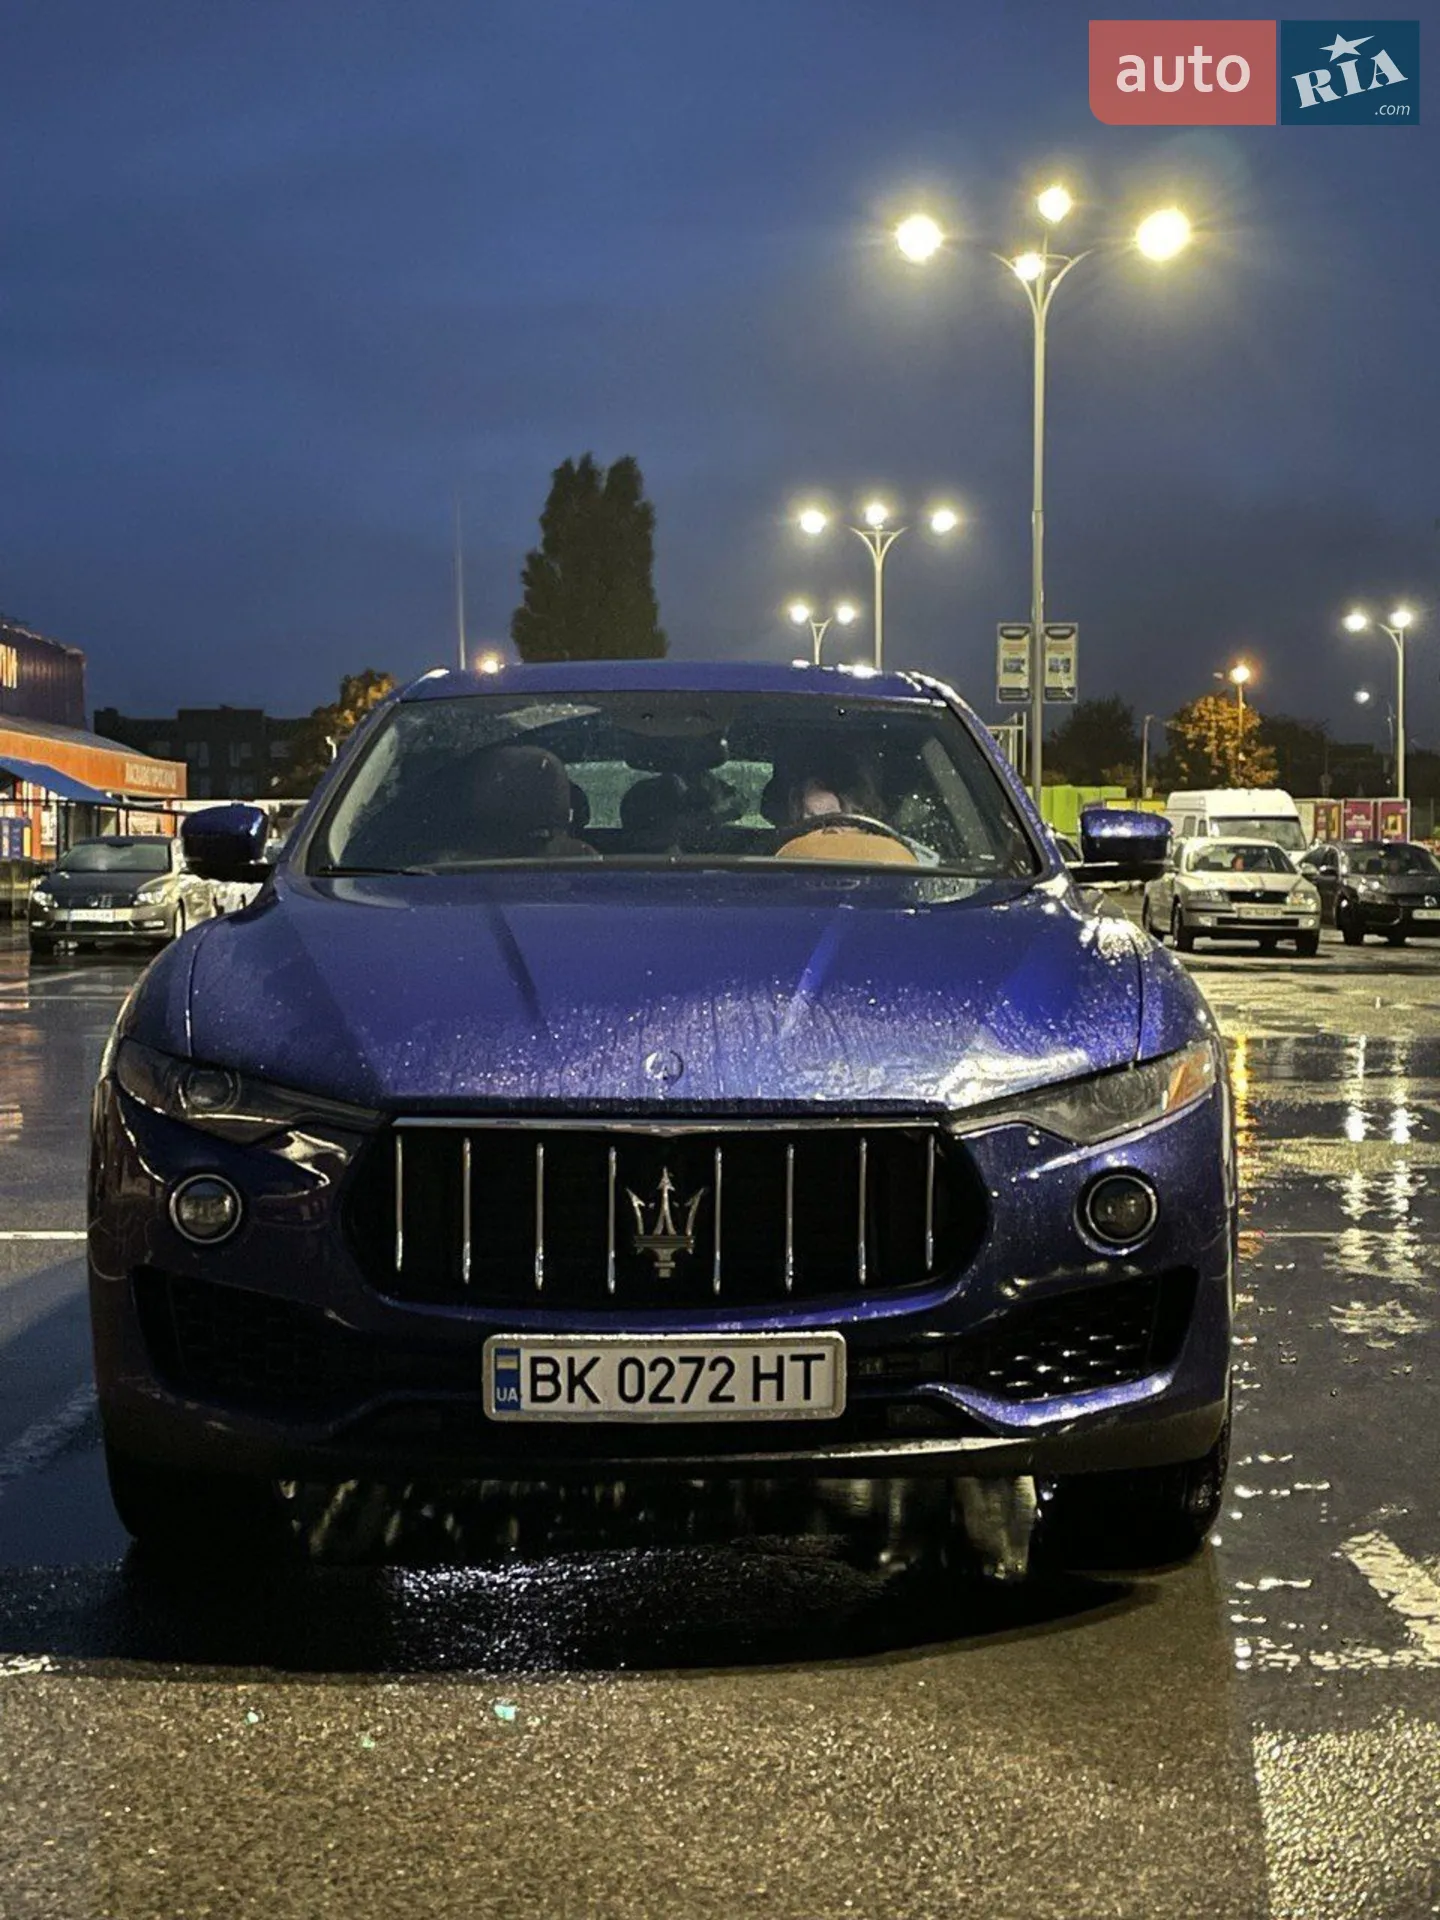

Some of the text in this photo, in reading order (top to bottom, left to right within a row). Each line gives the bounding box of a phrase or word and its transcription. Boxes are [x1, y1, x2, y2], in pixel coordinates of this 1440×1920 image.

[529, 1353, 826, 1404] BK 0272 HT
[496, 1389, 518, 1402] UA
